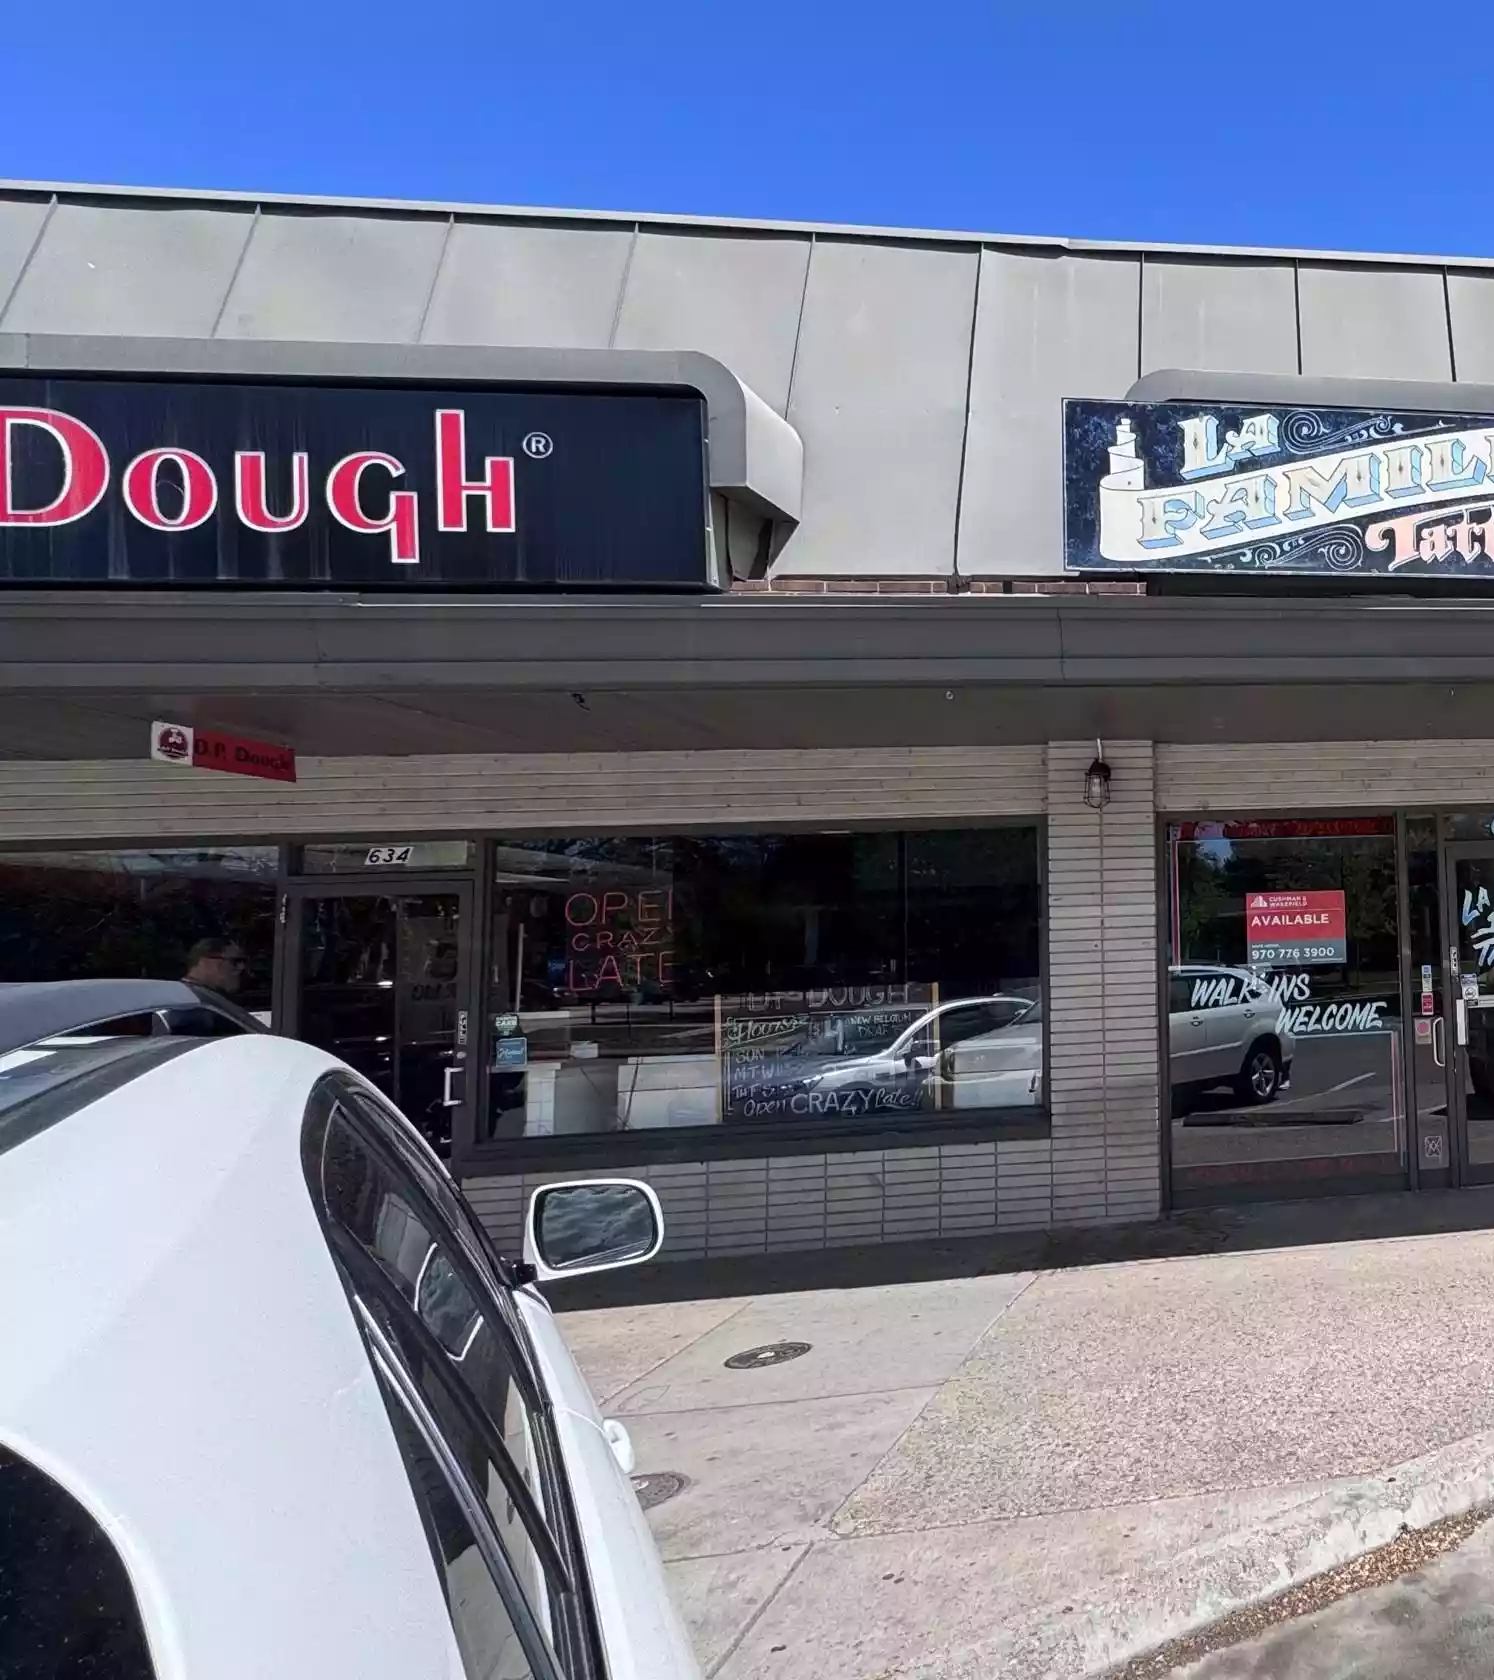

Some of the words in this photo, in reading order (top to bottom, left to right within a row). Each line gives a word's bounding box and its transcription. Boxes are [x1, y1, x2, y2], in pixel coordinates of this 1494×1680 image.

[1177, 413, 1280, 480] LA
[0, 406, 516, 563] Dough
[367, 847, 411, 864] 634
[1250, 913, 1330, 928] AVAILABLE
[1462, 885, 1491, 926] LA
[1251, 949, 1276, 960] 970
[1278, 948, 1301, 959] 776
[1303, 946, 1335, 958] 3900
[569, 950, 682, 991] LATE
[1274, 1001, 1388, 1035] WELCOME
[790, 1088, 875, 1115] CRAZY
